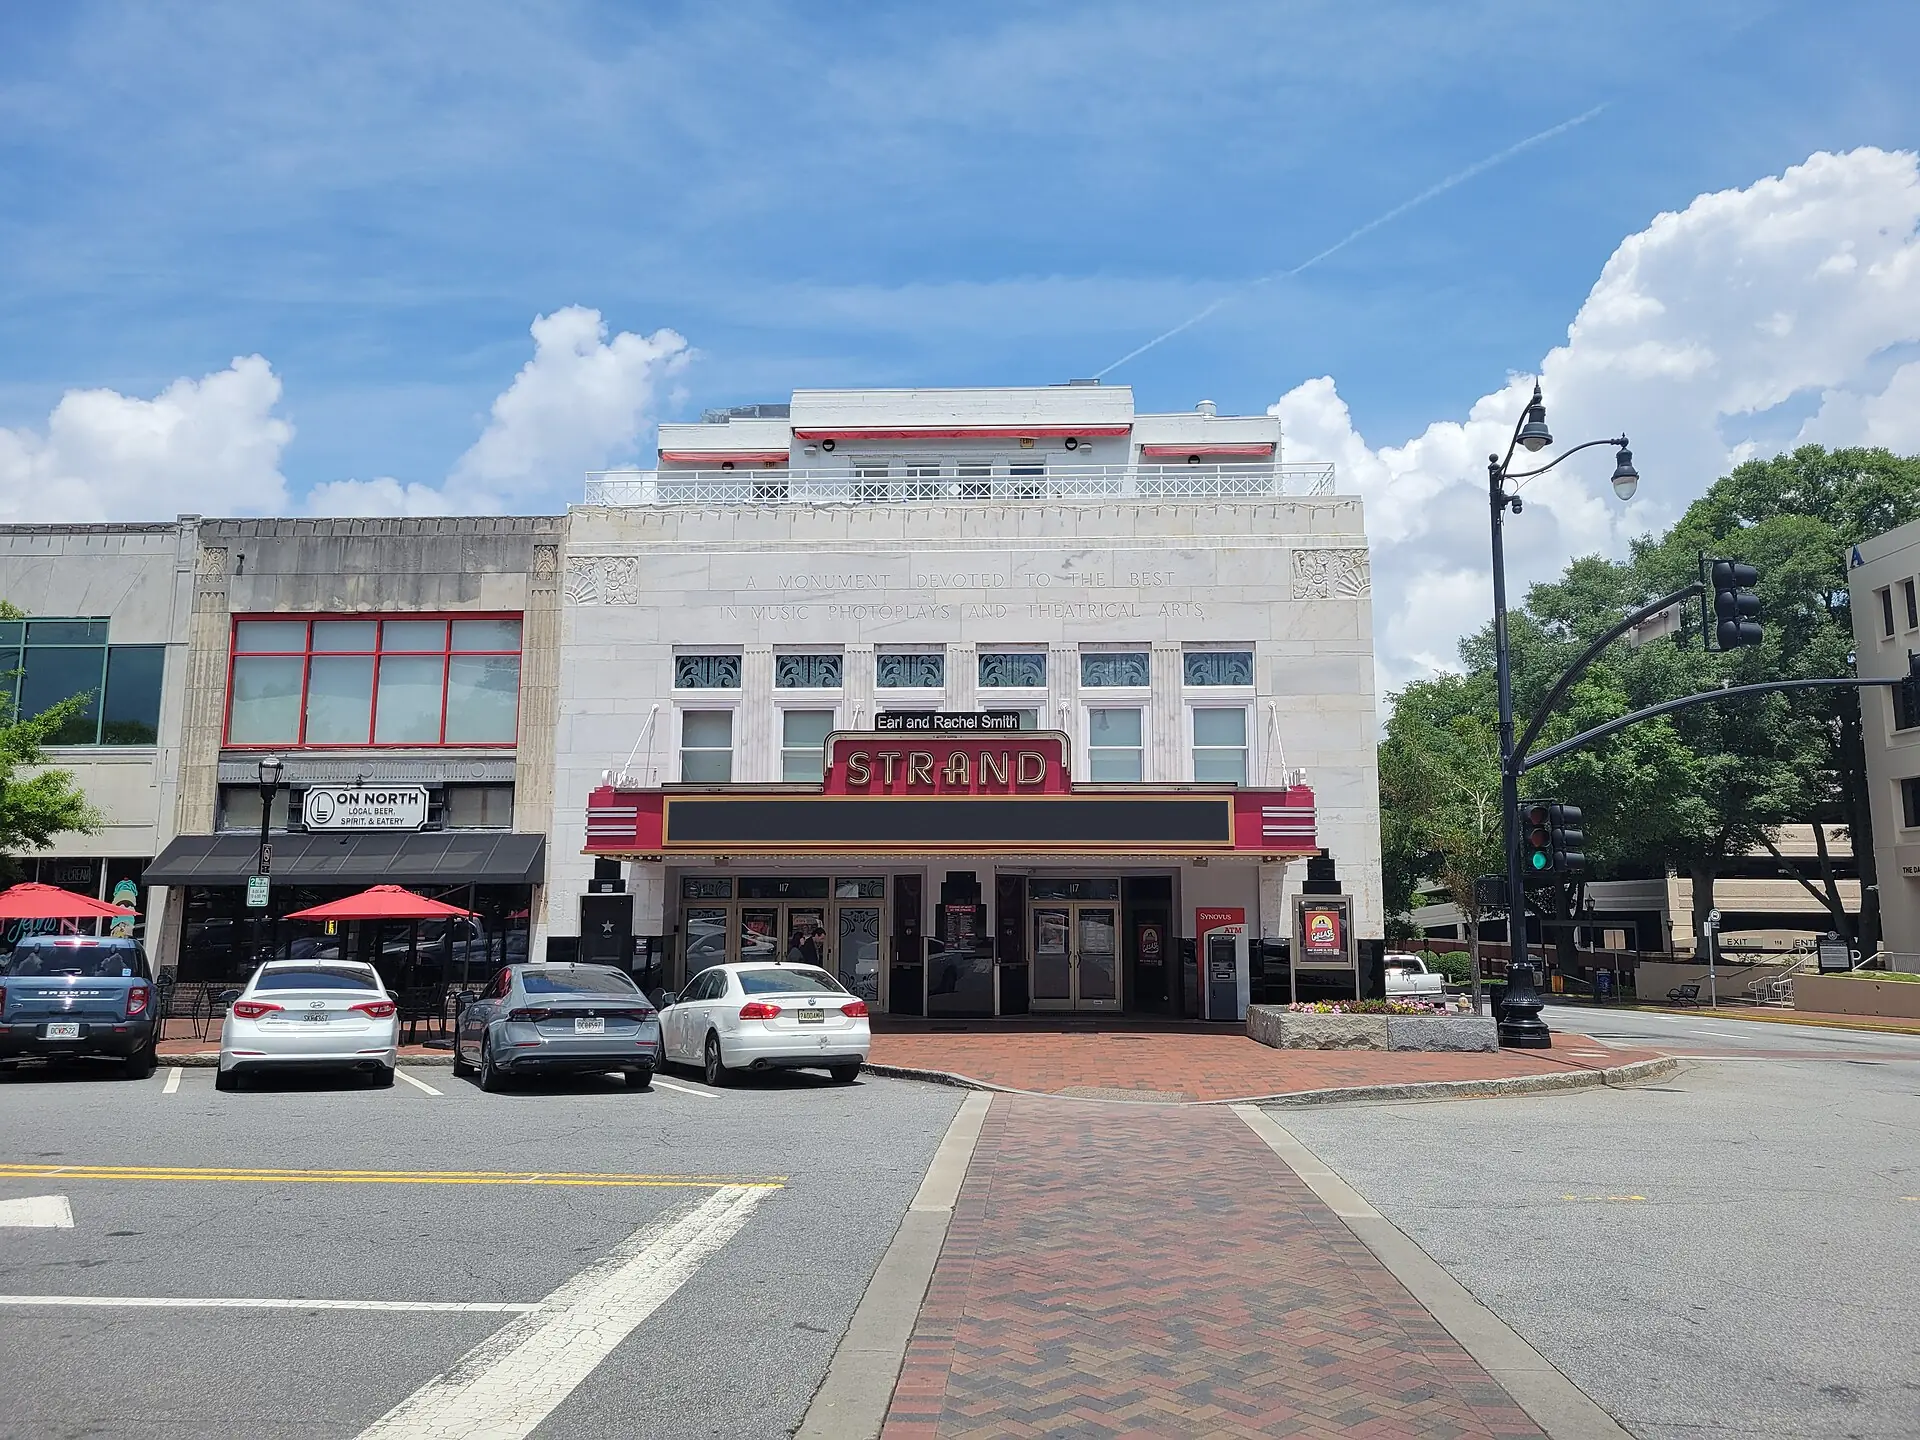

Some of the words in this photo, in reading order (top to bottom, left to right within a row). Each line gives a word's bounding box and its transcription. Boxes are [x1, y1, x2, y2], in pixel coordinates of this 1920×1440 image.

[1850, 545, 1865, 569] A
[745, 575, 757, 589] A
[777, 574, 891, 589] MONUMENT
[916, 573, 1005, 588] DEVOTED
[1024, 573, 1051, 588] TO
[1068, 572, 1106, 587] THE
[1129, 572, 1175, 587] BEST
[719, 605, 738, 620] IN
[751, 605, 809, 620] MUSIC
[828, 604, 951, 620] PHOTOPLAYS
[968, 604, 1007, 619] AND
[1026, 603, 1141, 619] THEATRICAL
[1158, 603, 1203, 617] ARTS
[878, 715, 903, 729] Earl
[906, 715, 930, 729] and
[933, 715, 978, 729] Rachel
[981, 714, 1018, 729] Smith
[848, 751, 1047, 785] STRAND
[336, 793, 360, 804] ON
[364, 793, 419, 804] NORTH
[348, 807, 372, 815] LOCAL
[376, 817, 405, 825] EATERY
[250, 878, 256, 886] 2
[779, 883, 790, 892] 117
[1069, 883, 1080, 893] 117
[1727, 938, 1748, 946] EXIT
